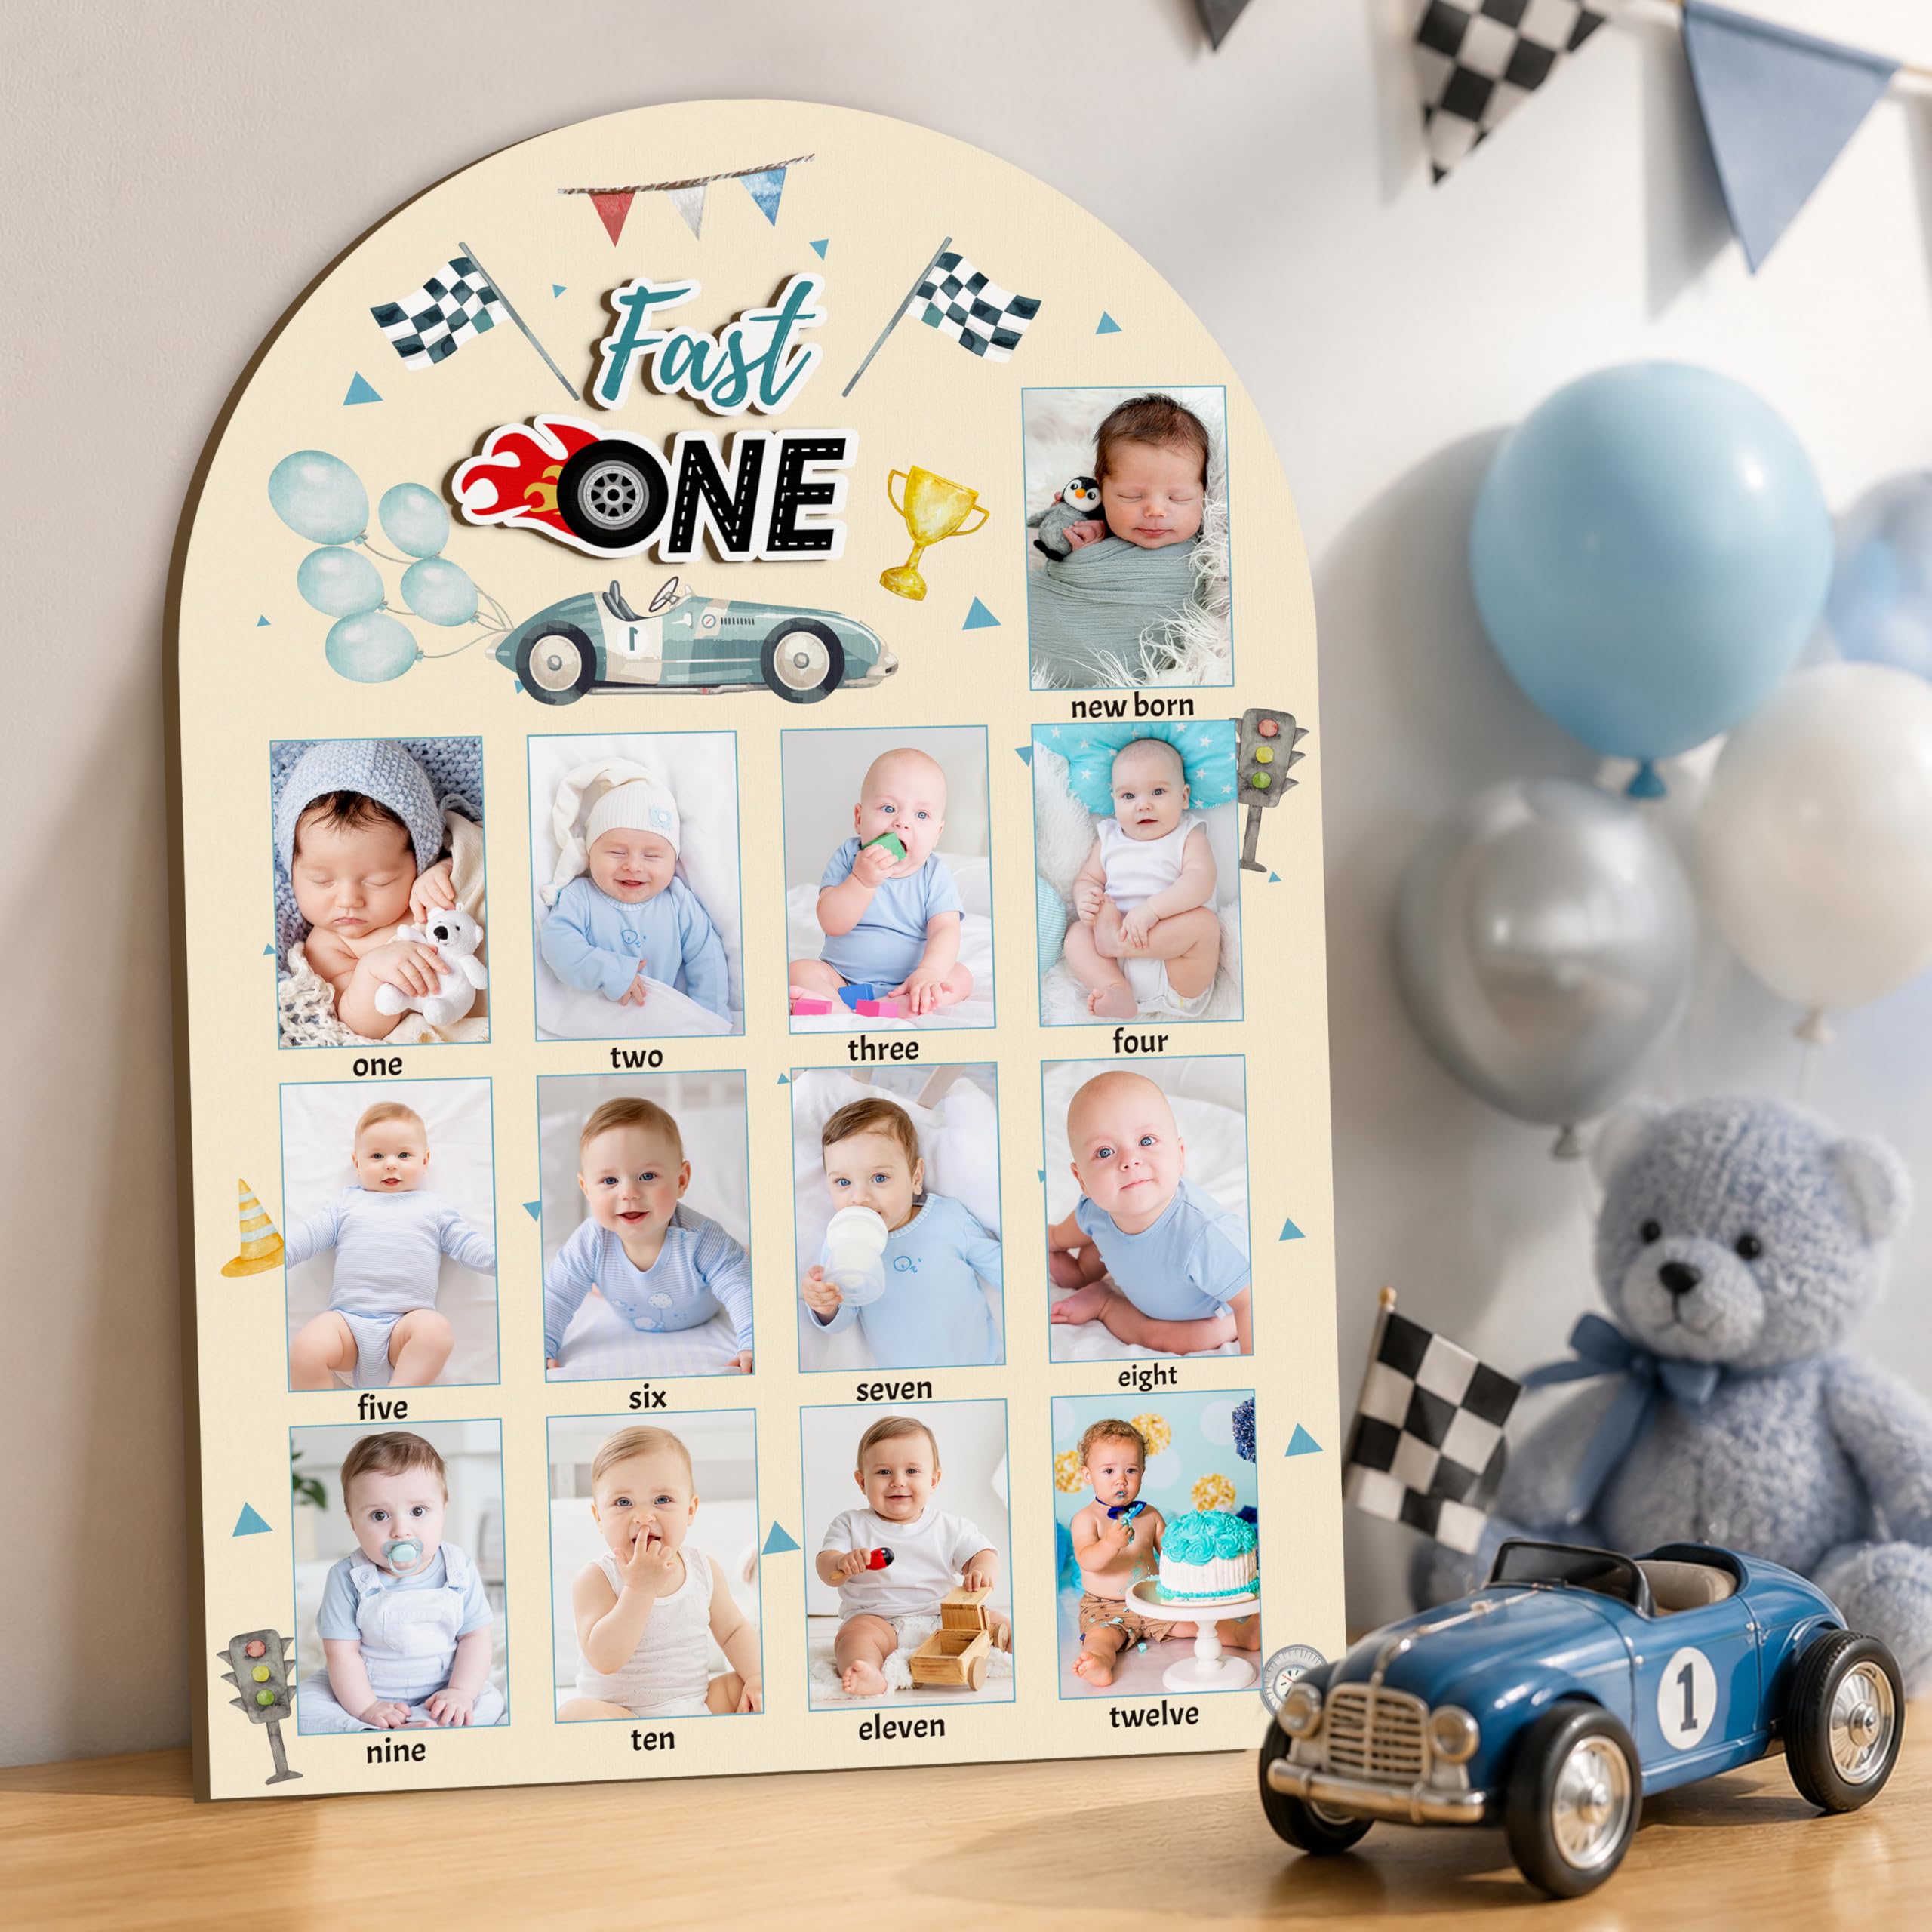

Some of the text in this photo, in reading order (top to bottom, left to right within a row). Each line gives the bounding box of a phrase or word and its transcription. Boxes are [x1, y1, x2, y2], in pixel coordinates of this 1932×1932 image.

[601, 281, 815, 407] Fast
[1072, 691, 1194, 718] new born
[848, 1035, 919, 1062] three
[1112, 1026, 1168, 1054] four
[352, 1057, 403, 1077] one
[610, 1047, 663, 1069] two
[1118, 1362, 1178, 1392] eight
[629, 1383, 667, 1410] six
[856, 1381, 932, 1401] seven
[357, 1393, 408, 1420] five
[1677, 1662, 1697, 1732] 1
[859, 1713, 945, 1740] eleven
[1109, 1699, 1199, 1728] twelve
[367, 1737, 426, 1764] nine
[630, 1727, 675, 1751] ten
